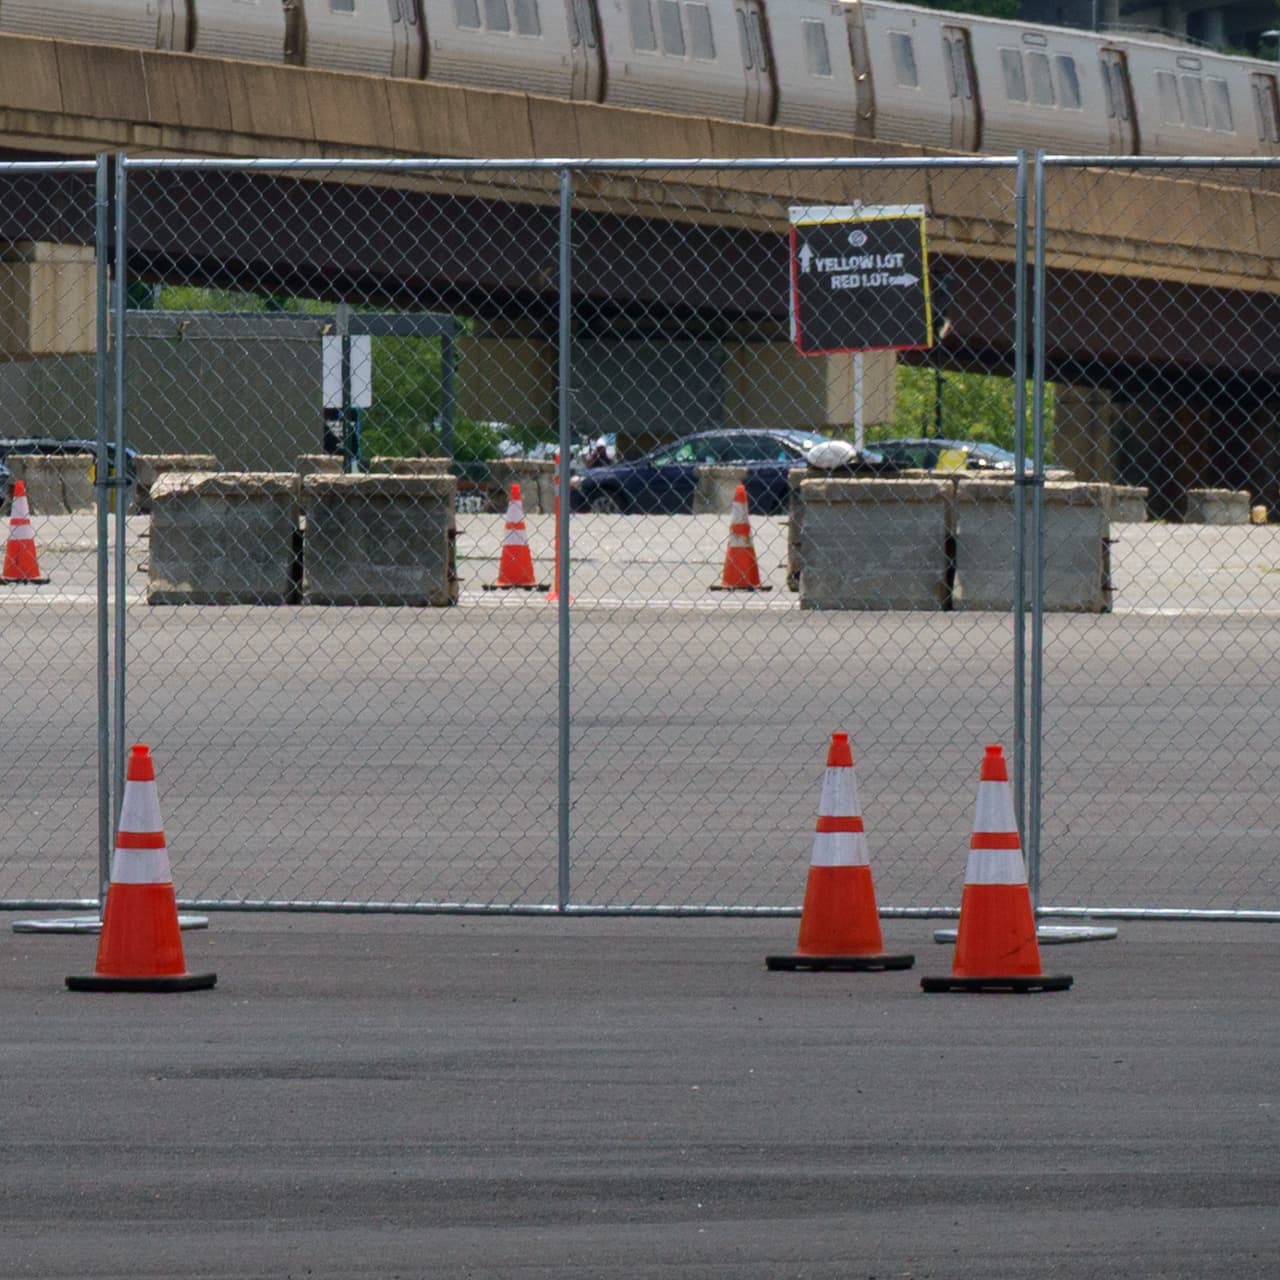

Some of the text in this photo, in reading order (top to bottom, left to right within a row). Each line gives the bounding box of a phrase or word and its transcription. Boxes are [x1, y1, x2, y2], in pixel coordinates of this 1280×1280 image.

[815, 252, 904, 272] YELLOW LOT
[831, 272, 889, 290] RED LOT
